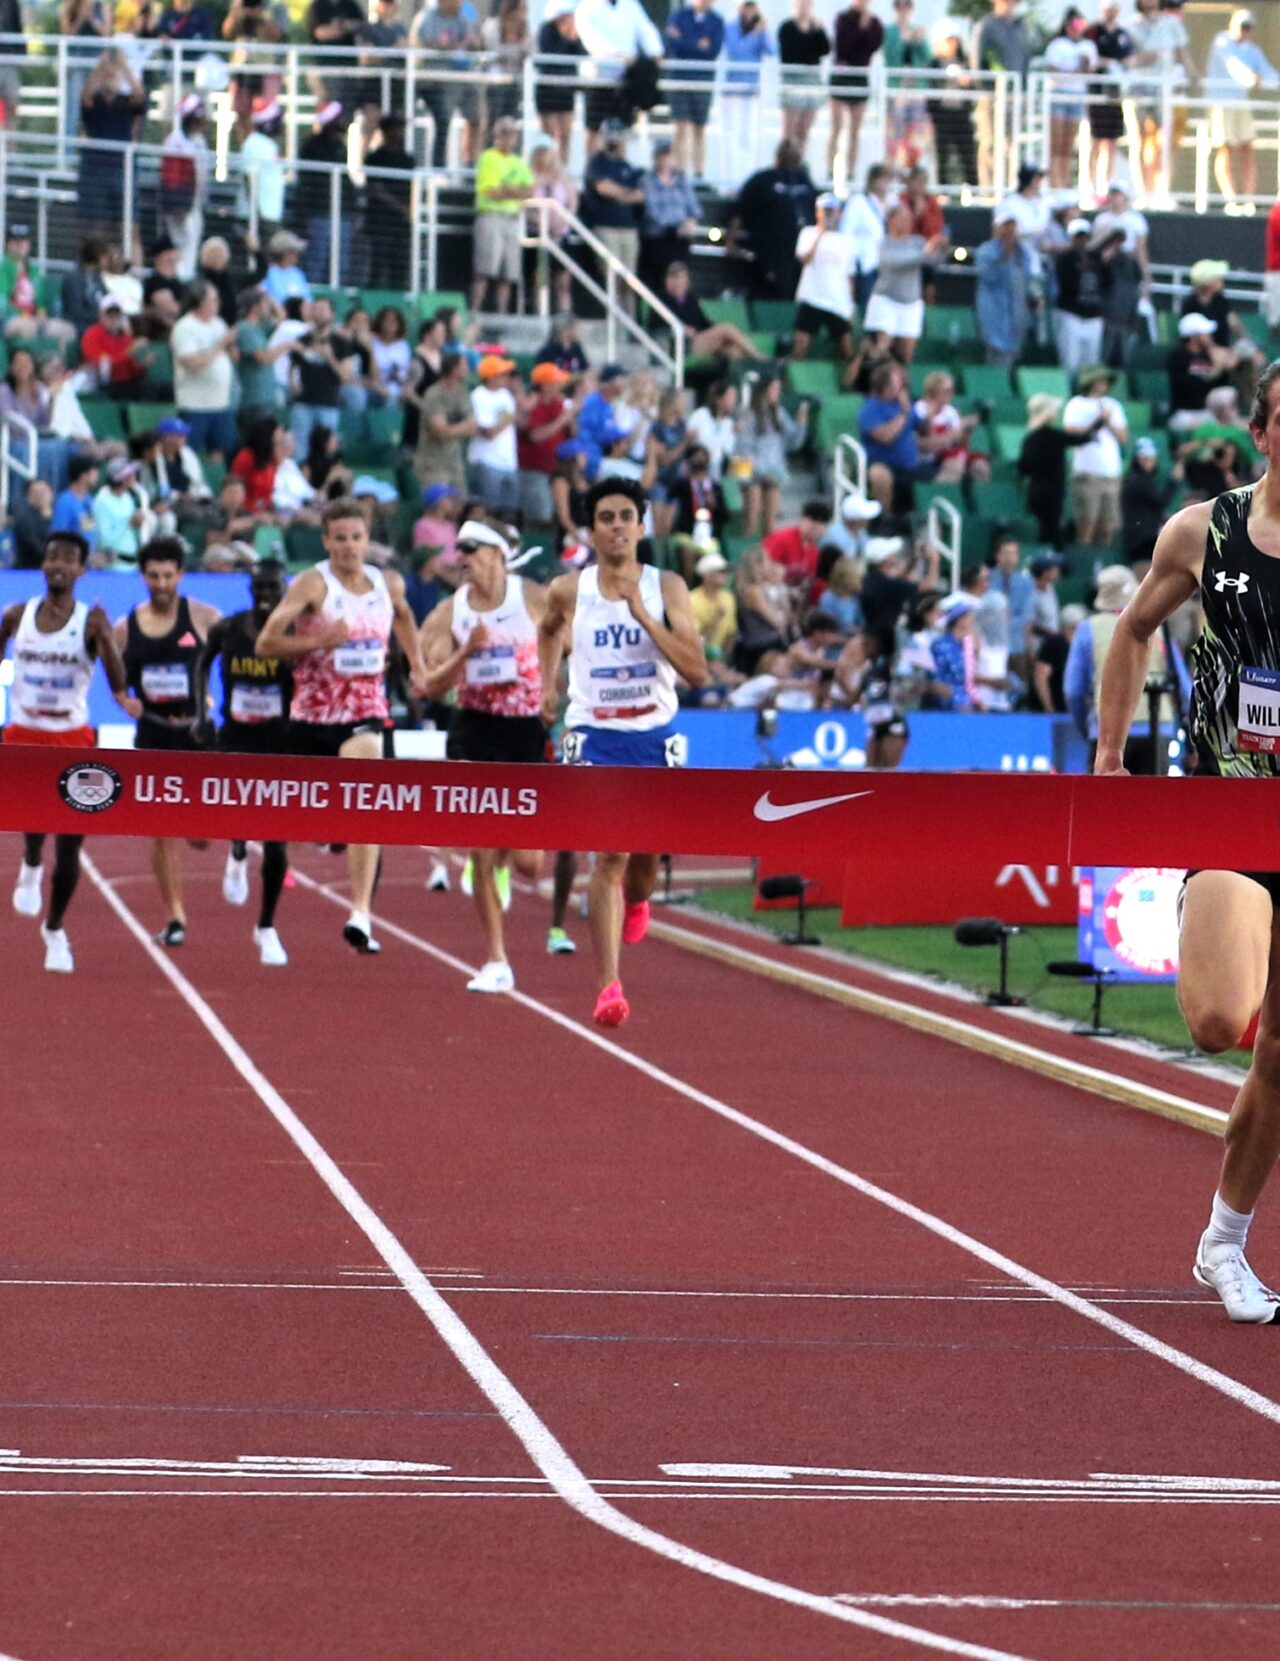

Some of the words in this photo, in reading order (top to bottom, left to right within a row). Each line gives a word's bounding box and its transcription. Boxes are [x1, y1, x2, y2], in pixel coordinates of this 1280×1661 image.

[594, 624, 640, 648] BYU
[231, 656, 279, 677] ARMY
[599, 685, 651, 702] CORRIGAN
[134, 774, 190, 803] U.S.
[201, 777, 329, 808] OLYMPIC
[339, 782, 421, 812] TEAM
[431, 785, 537, 816] TRIALS
